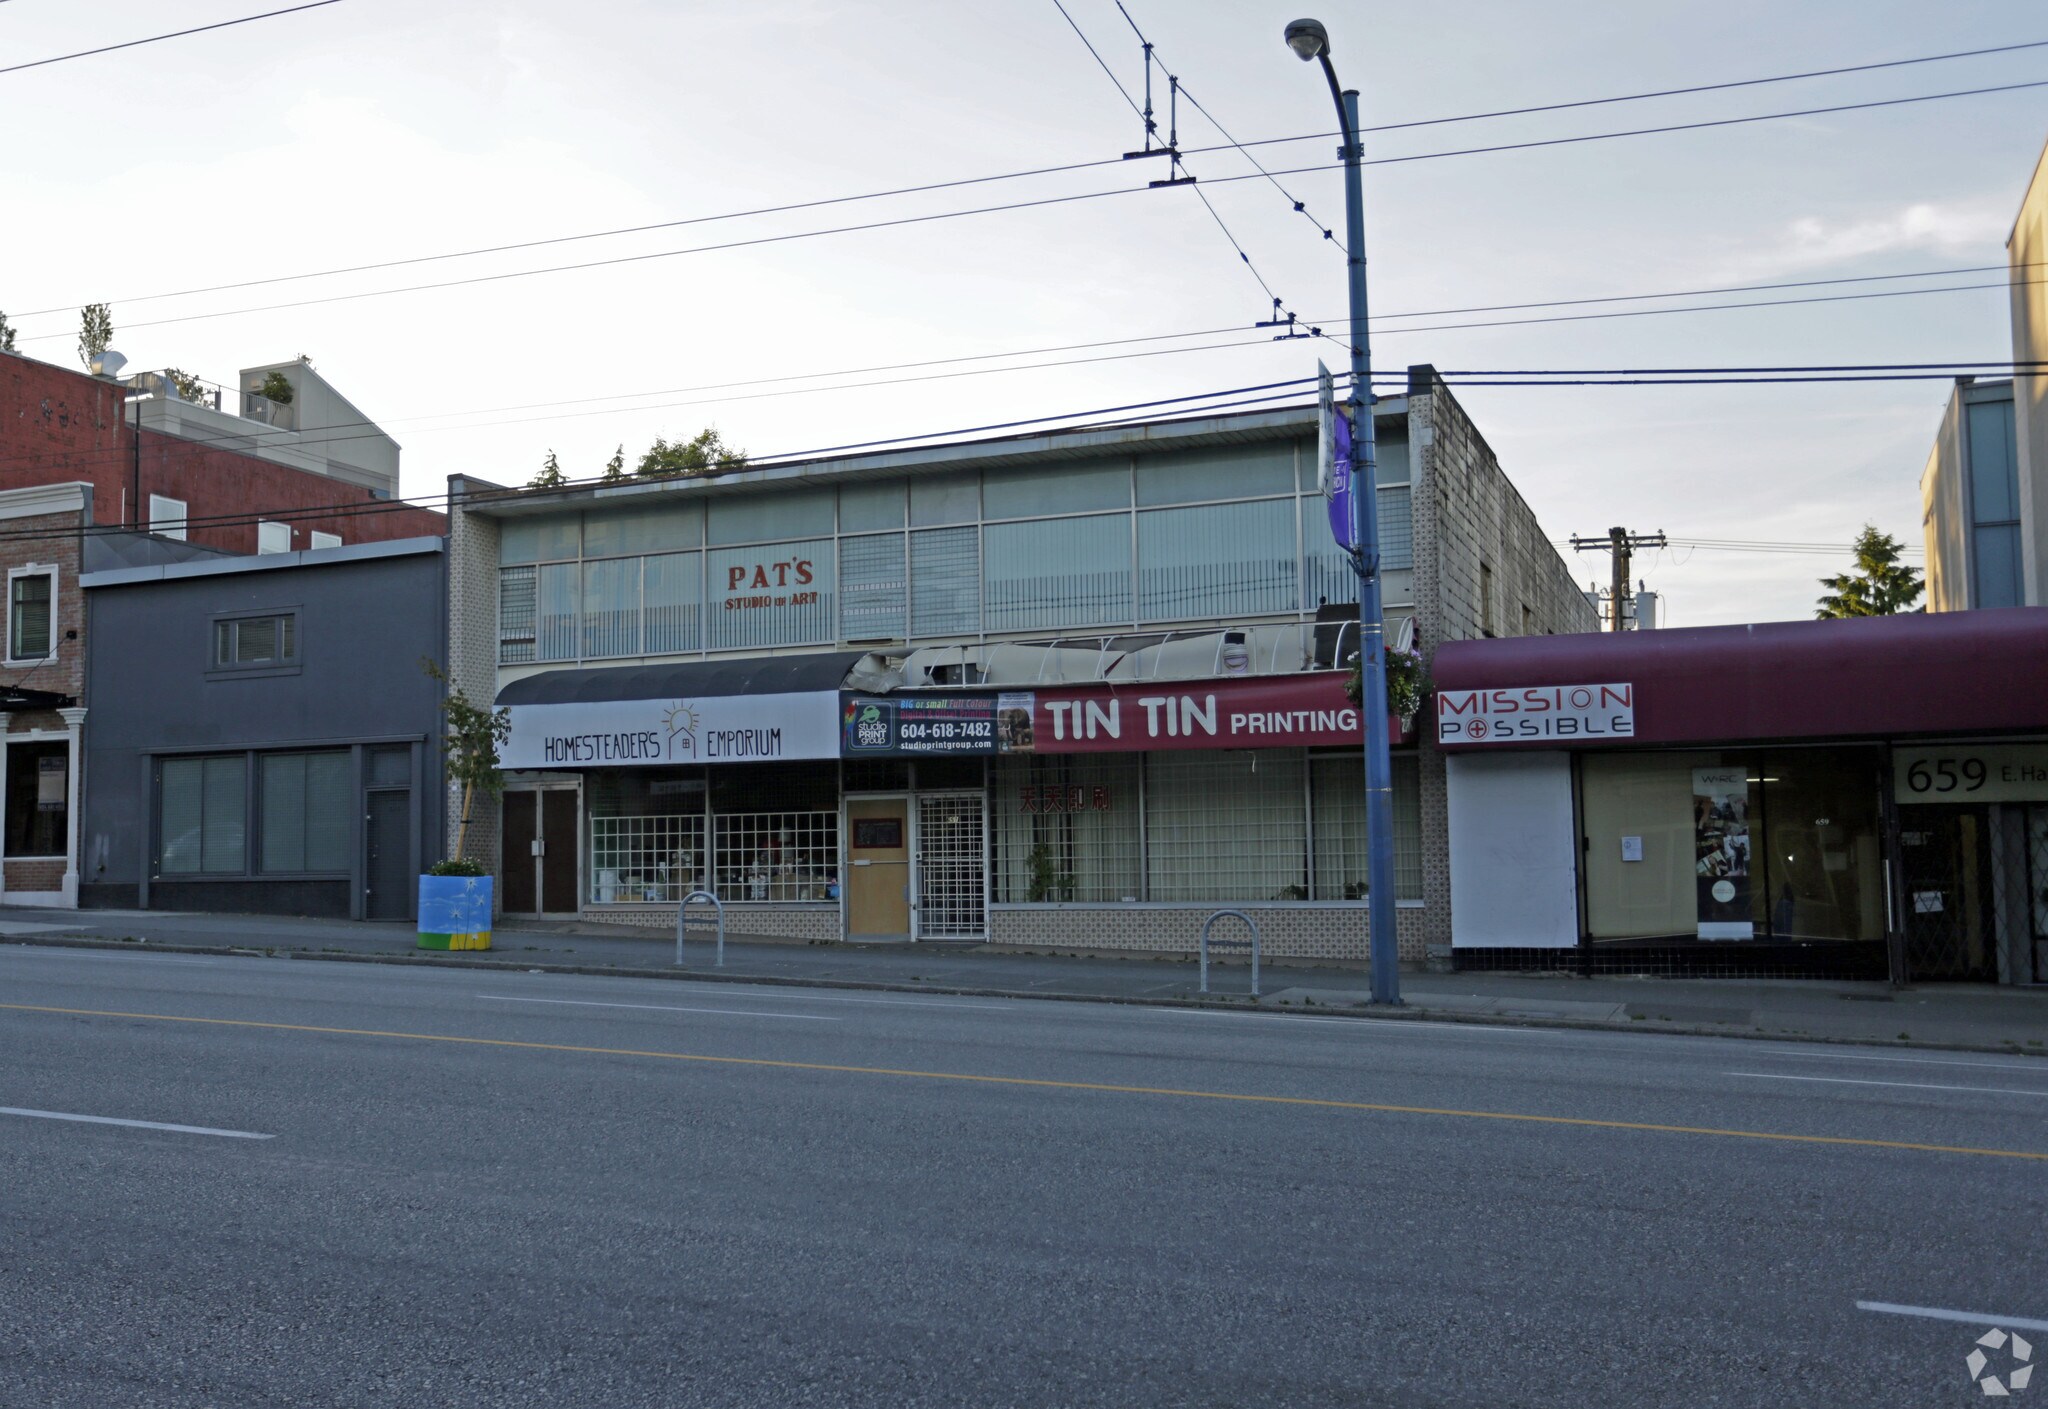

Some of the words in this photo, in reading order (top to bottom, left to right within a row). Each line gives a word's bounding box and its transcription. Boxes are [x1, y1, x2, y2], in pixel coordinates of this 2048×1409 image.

[728, 557, 813, 590] PAT'S
[725, 596, 772, 610] STUDIO
[791, 592, 817, 606] ART
[900, 700, 914, 709] BIG
[926, 700, 947, 709] small
[966, 700, 992, 708] Colour
[1440, 685, 1630, 715] MISSION
[858, 721, 887, 731] studio
[1045, 699, 1120, 740] TIN
[1138, 695, 1217, 737] TIN
[1231, 709, 1357, 734] PRINTING
[1440, 715, 1632, 740] POSSIBLE
[858, 731, 886, 739] PRINT
[901, 723, 991, 738] 604-618-7482
[545, 731, 661, 762] HOMESTEADER'S
[707, 728, 781, 757] EMPORIUM
[900, 741, 992, 750] studioprintgroup.com
[1908, 758, 1987, 793] 659
[2002, 766, 2017, 782] E.
[1020, 785, 1110, 813] 天天印刷
